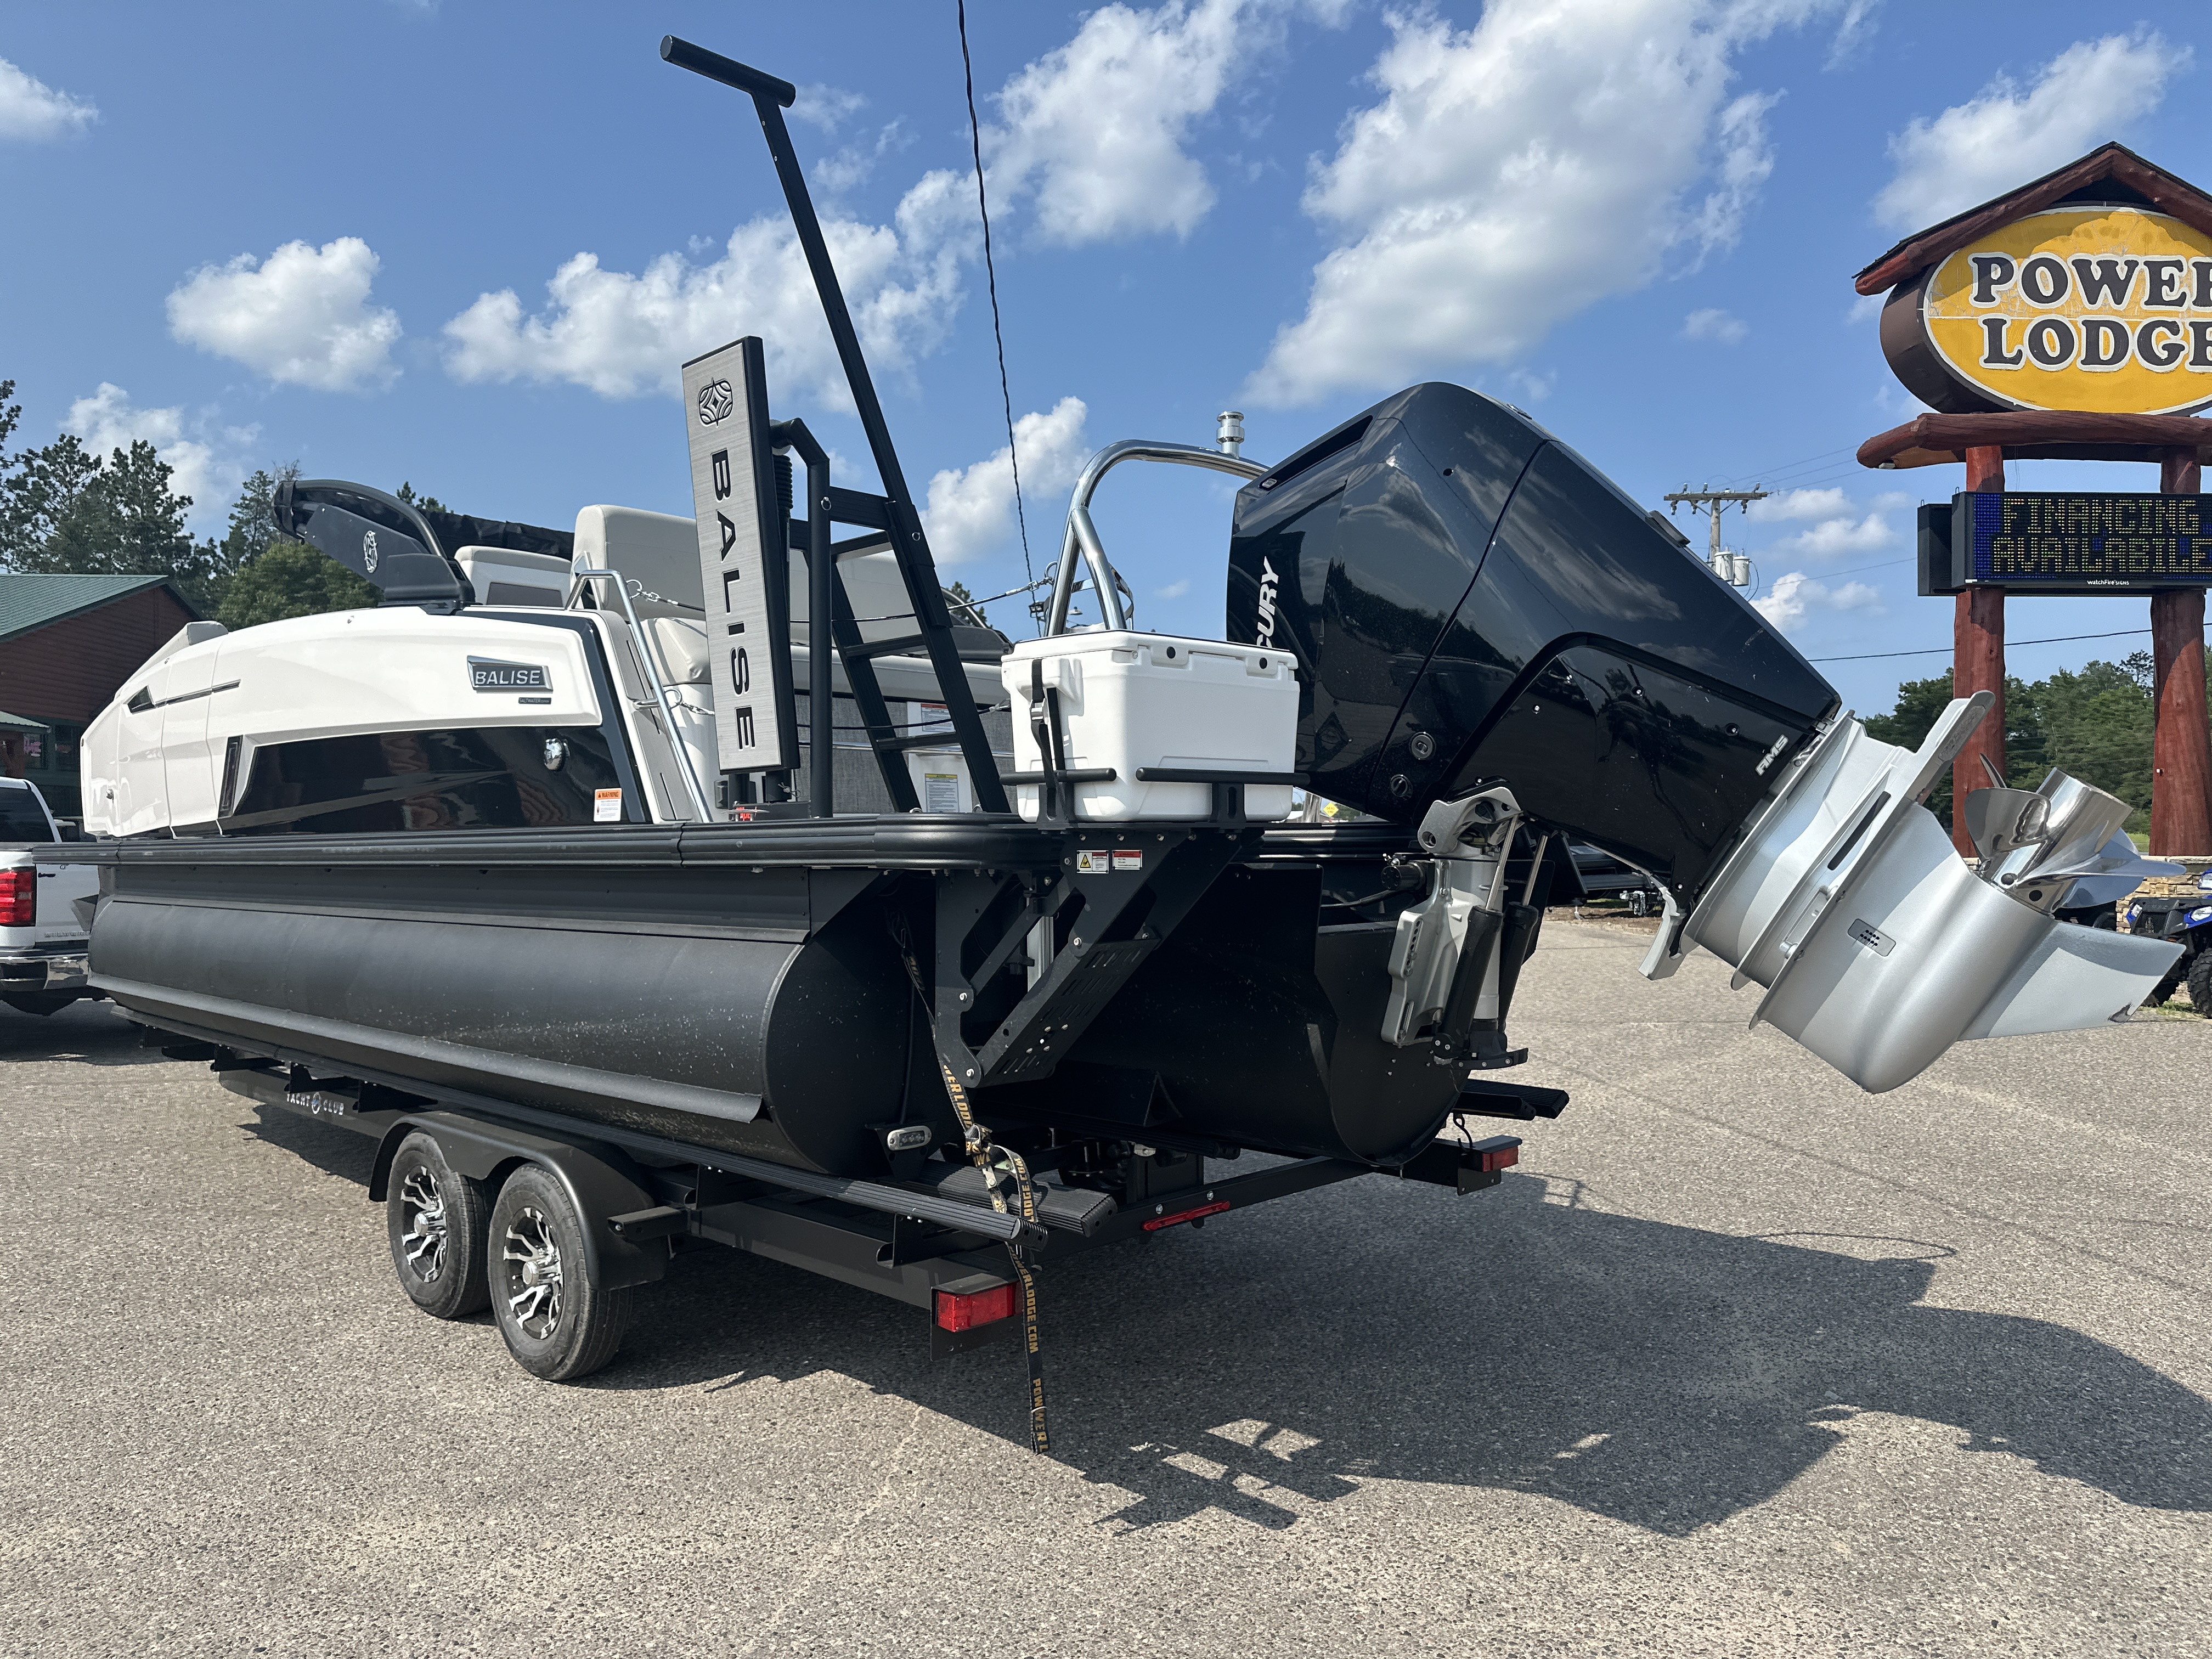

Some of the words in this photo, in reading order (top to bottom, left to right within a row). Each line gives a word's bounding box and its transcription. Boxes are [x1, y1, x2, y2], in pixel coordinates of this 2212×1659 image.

[2004, 499, 2199, 534] FINANCING
[711, 448, 756, 751] BALISE
[475, 670, 541, 685] BALISE
[1756, 735, 1788, 775] AMS
[287, 1093, 310, 1107] YACHT
[324, 1099, 344, 1115] CLUB
